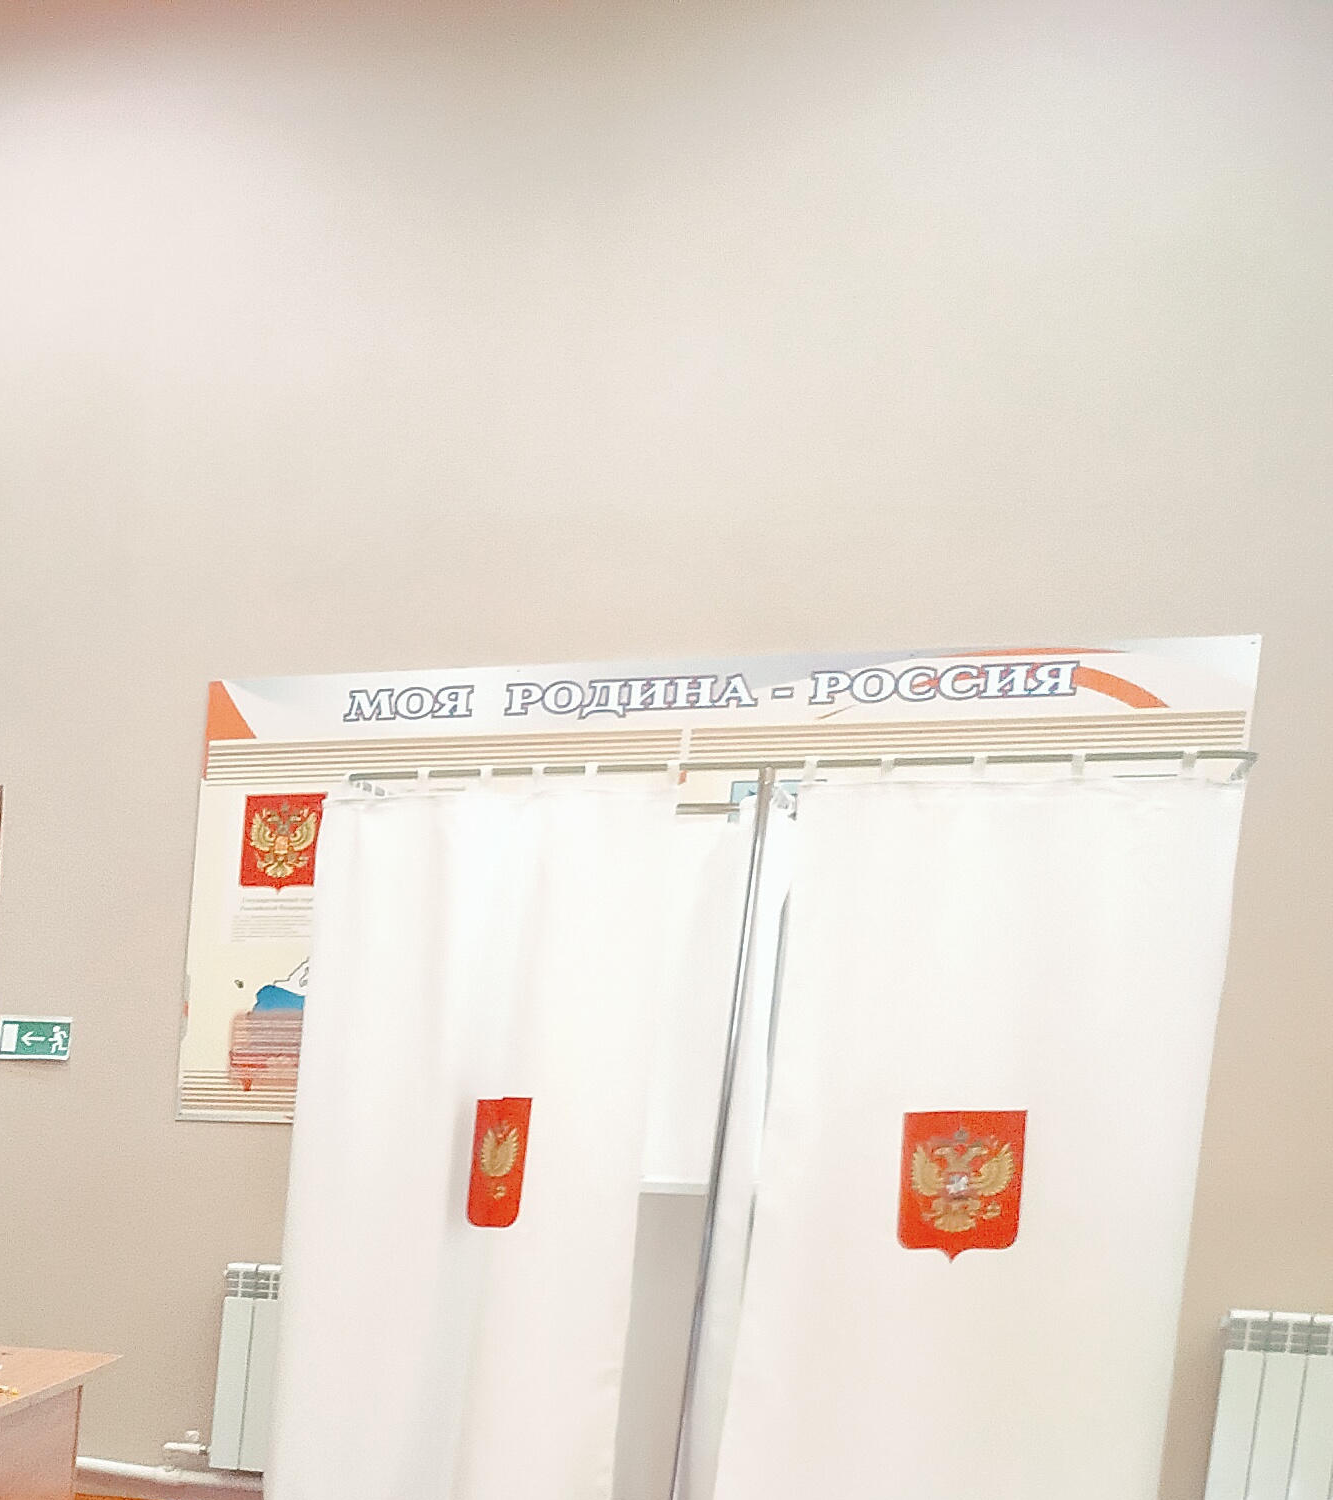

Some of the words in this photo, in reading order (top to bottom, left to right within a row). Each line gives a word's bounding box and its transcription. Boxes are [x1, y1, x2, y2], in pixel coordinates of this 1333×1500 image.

[343, 684, 475, 723] МОЯ
[503, 673, 758, 720] РОДИНА
[808, 660, 1081, 706] РОССИЯ
